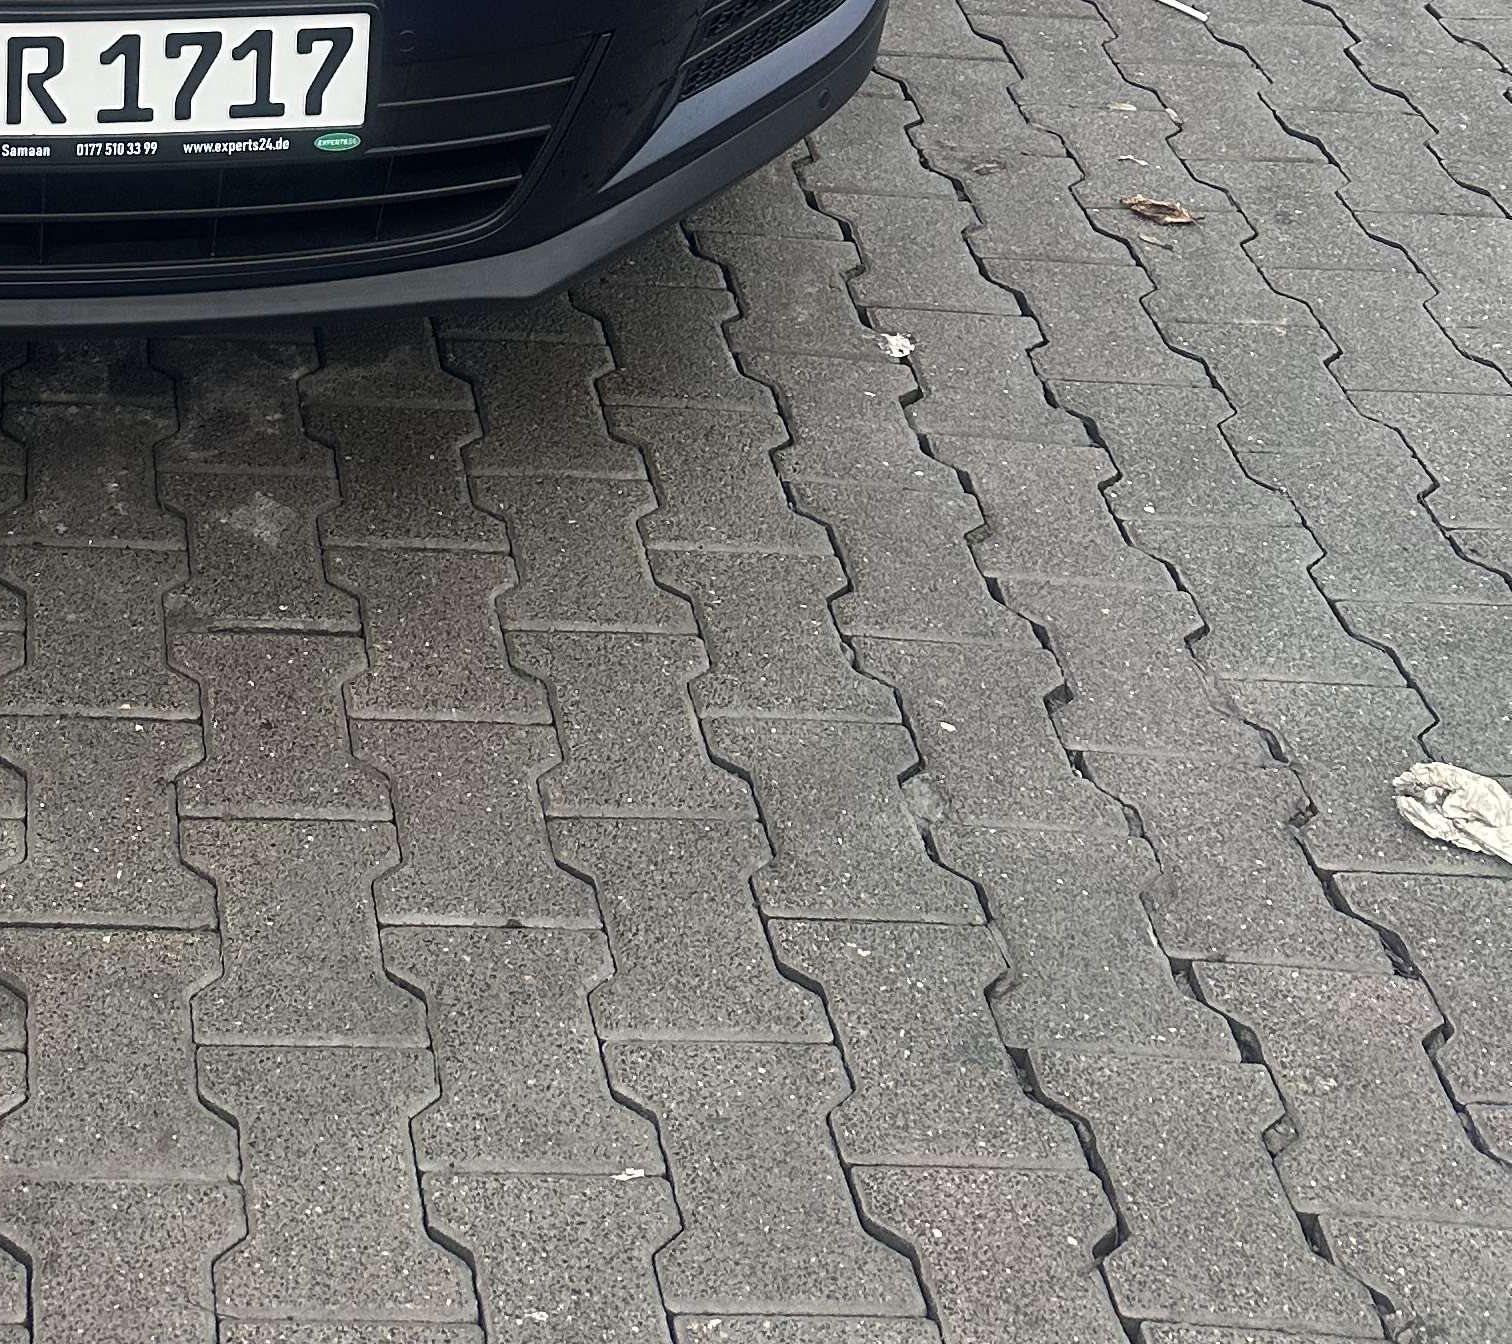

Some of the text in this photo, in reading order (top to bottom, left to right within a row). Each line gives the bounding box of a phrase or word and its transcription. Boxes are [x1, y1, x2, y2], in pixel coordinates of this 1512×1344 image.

[97, 26, 354, 124] 1717
[1, 143, 51, 157] Samaan
[76, 143, 102, 156] 0177
[104, 142, 125, 156] 510
[126, 142, 141, 155] 33
[143, 141, 158, 155] 99
[183, 137, 290, 155] www.experts24.de
